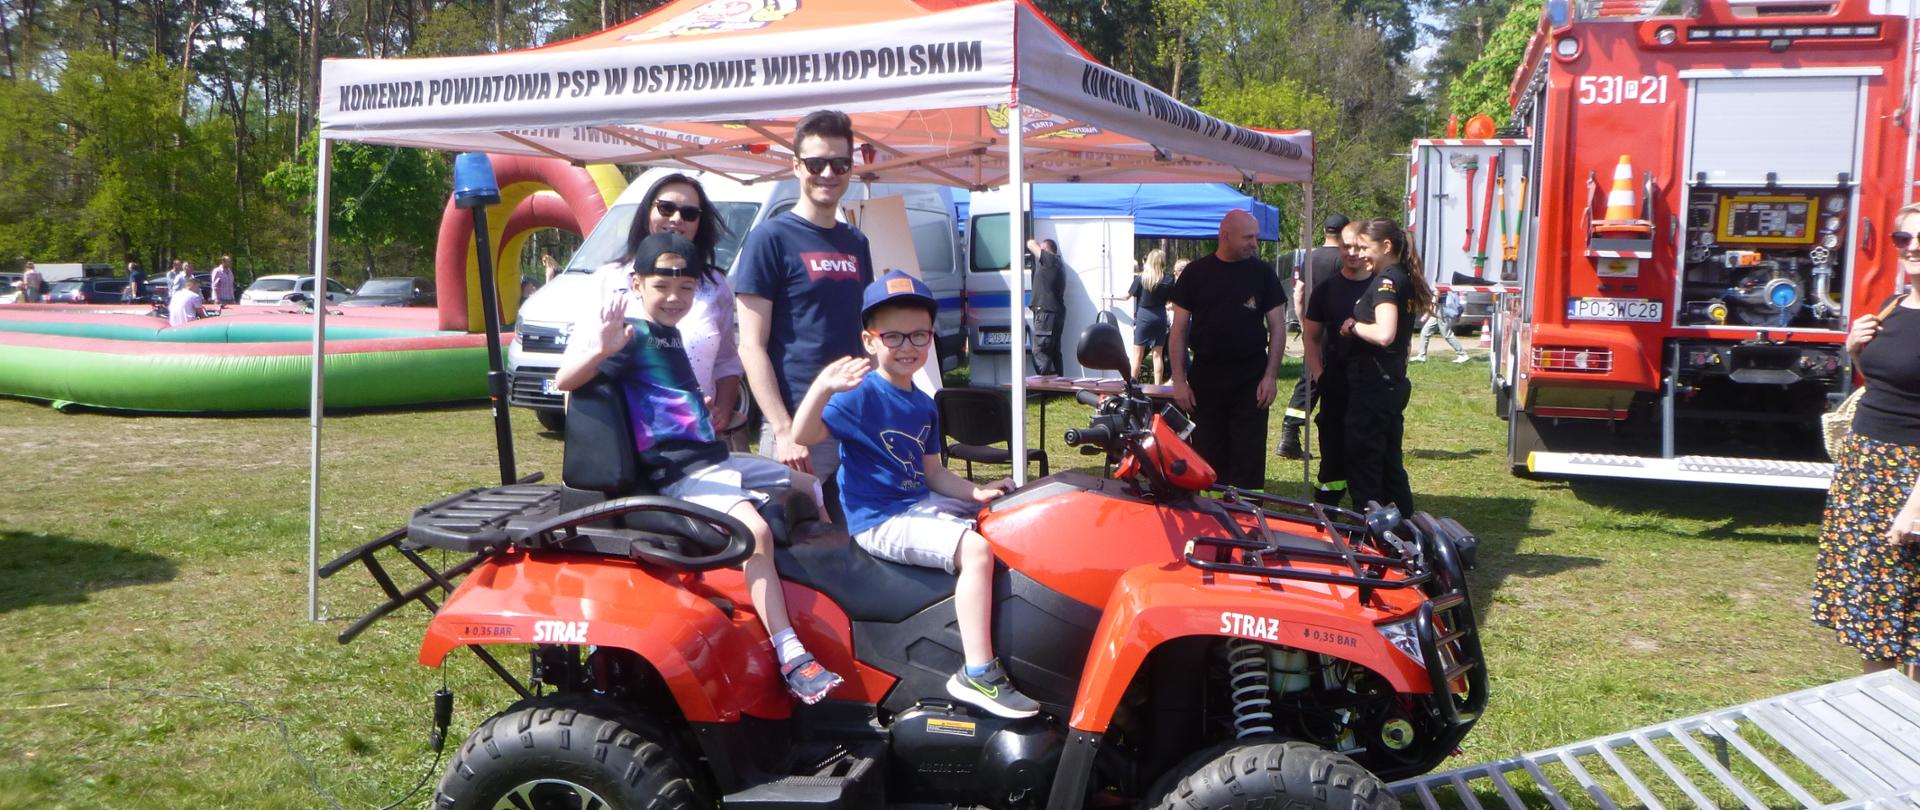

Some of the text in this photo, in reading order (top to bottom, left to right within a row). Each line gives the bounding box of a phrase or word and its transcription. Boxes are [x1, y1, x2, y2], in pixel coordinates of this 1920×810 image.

[339, 40, 983, 112] KOMENDA POWIATOWA PSP W OSTROWIE WIELKOPOLSKIM
[1082, 64, 1140, 112] KOMENDA
[1579, 75, 1624, 104] 531
[1640, 75, 1668, 104] 21
[1579, 301, 1658, 318] PO 3WC28
[493, 627, 513, 636] BAR
[1336, 634, 1357, 648] BAR
